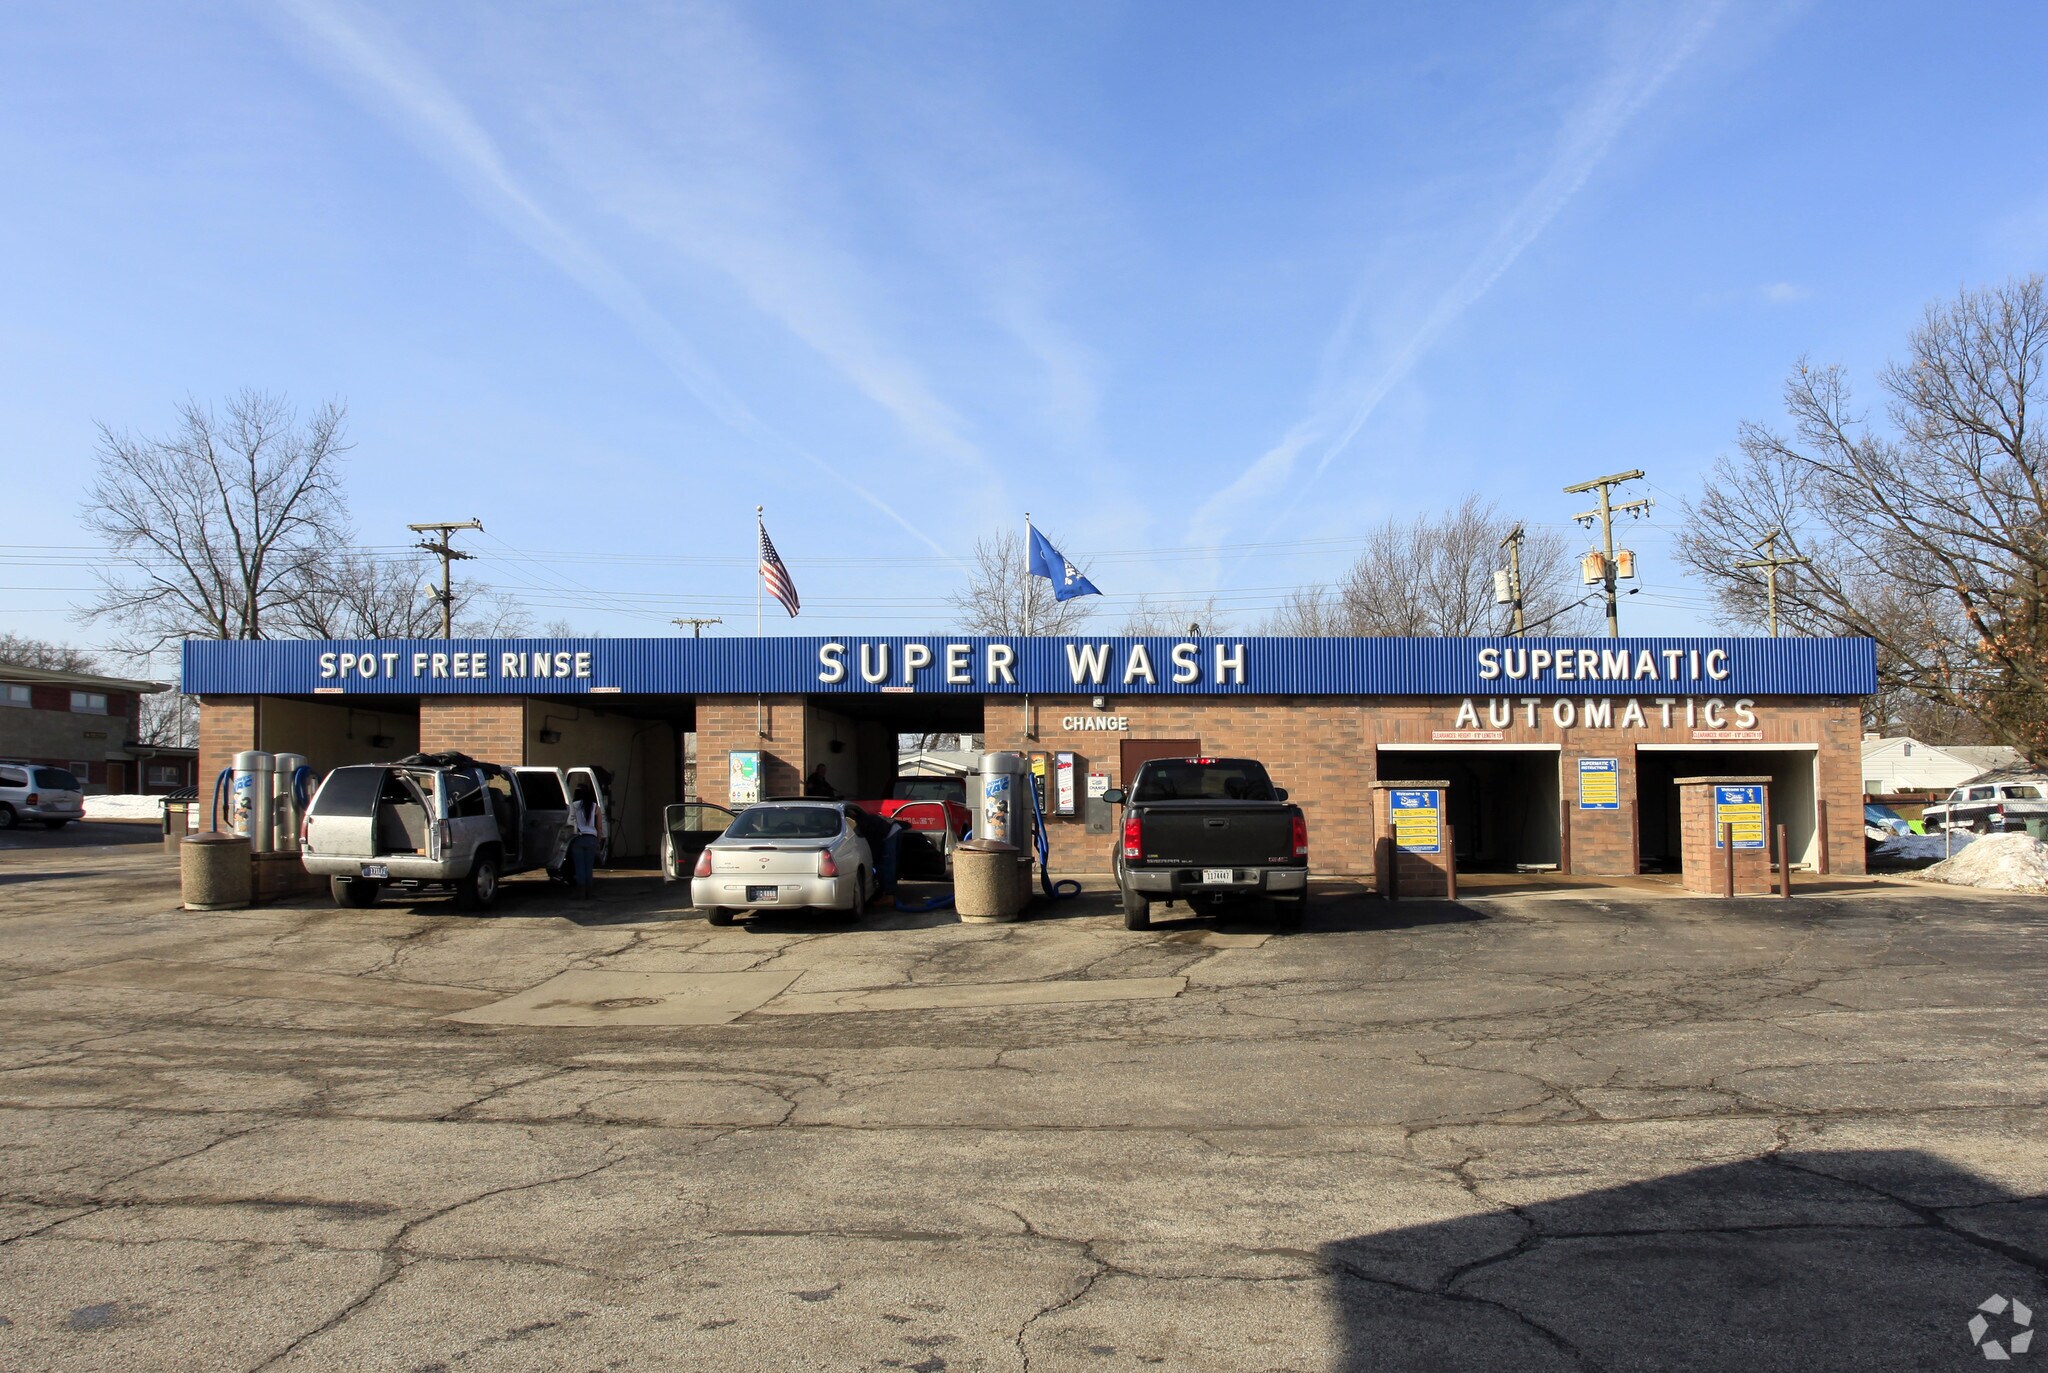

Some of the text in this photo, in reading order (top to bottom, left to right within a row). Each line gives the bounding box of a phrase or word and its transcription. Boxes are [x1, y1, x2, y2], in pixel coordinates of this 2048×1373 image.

[320, 652, 591, 678] SPOT FREE RINSE
[819, 642, 1244, 684] SUPER WASH
[1478, 648, 1729, 680] SUPERMATIC
[1062, 716, 1129, 731] CHANGE
[1455, 698, 1756, 729] AUTOMATICS
[986, 780, 1009, 796] VAC
[1207, 872, 1230, 880] 1174447
